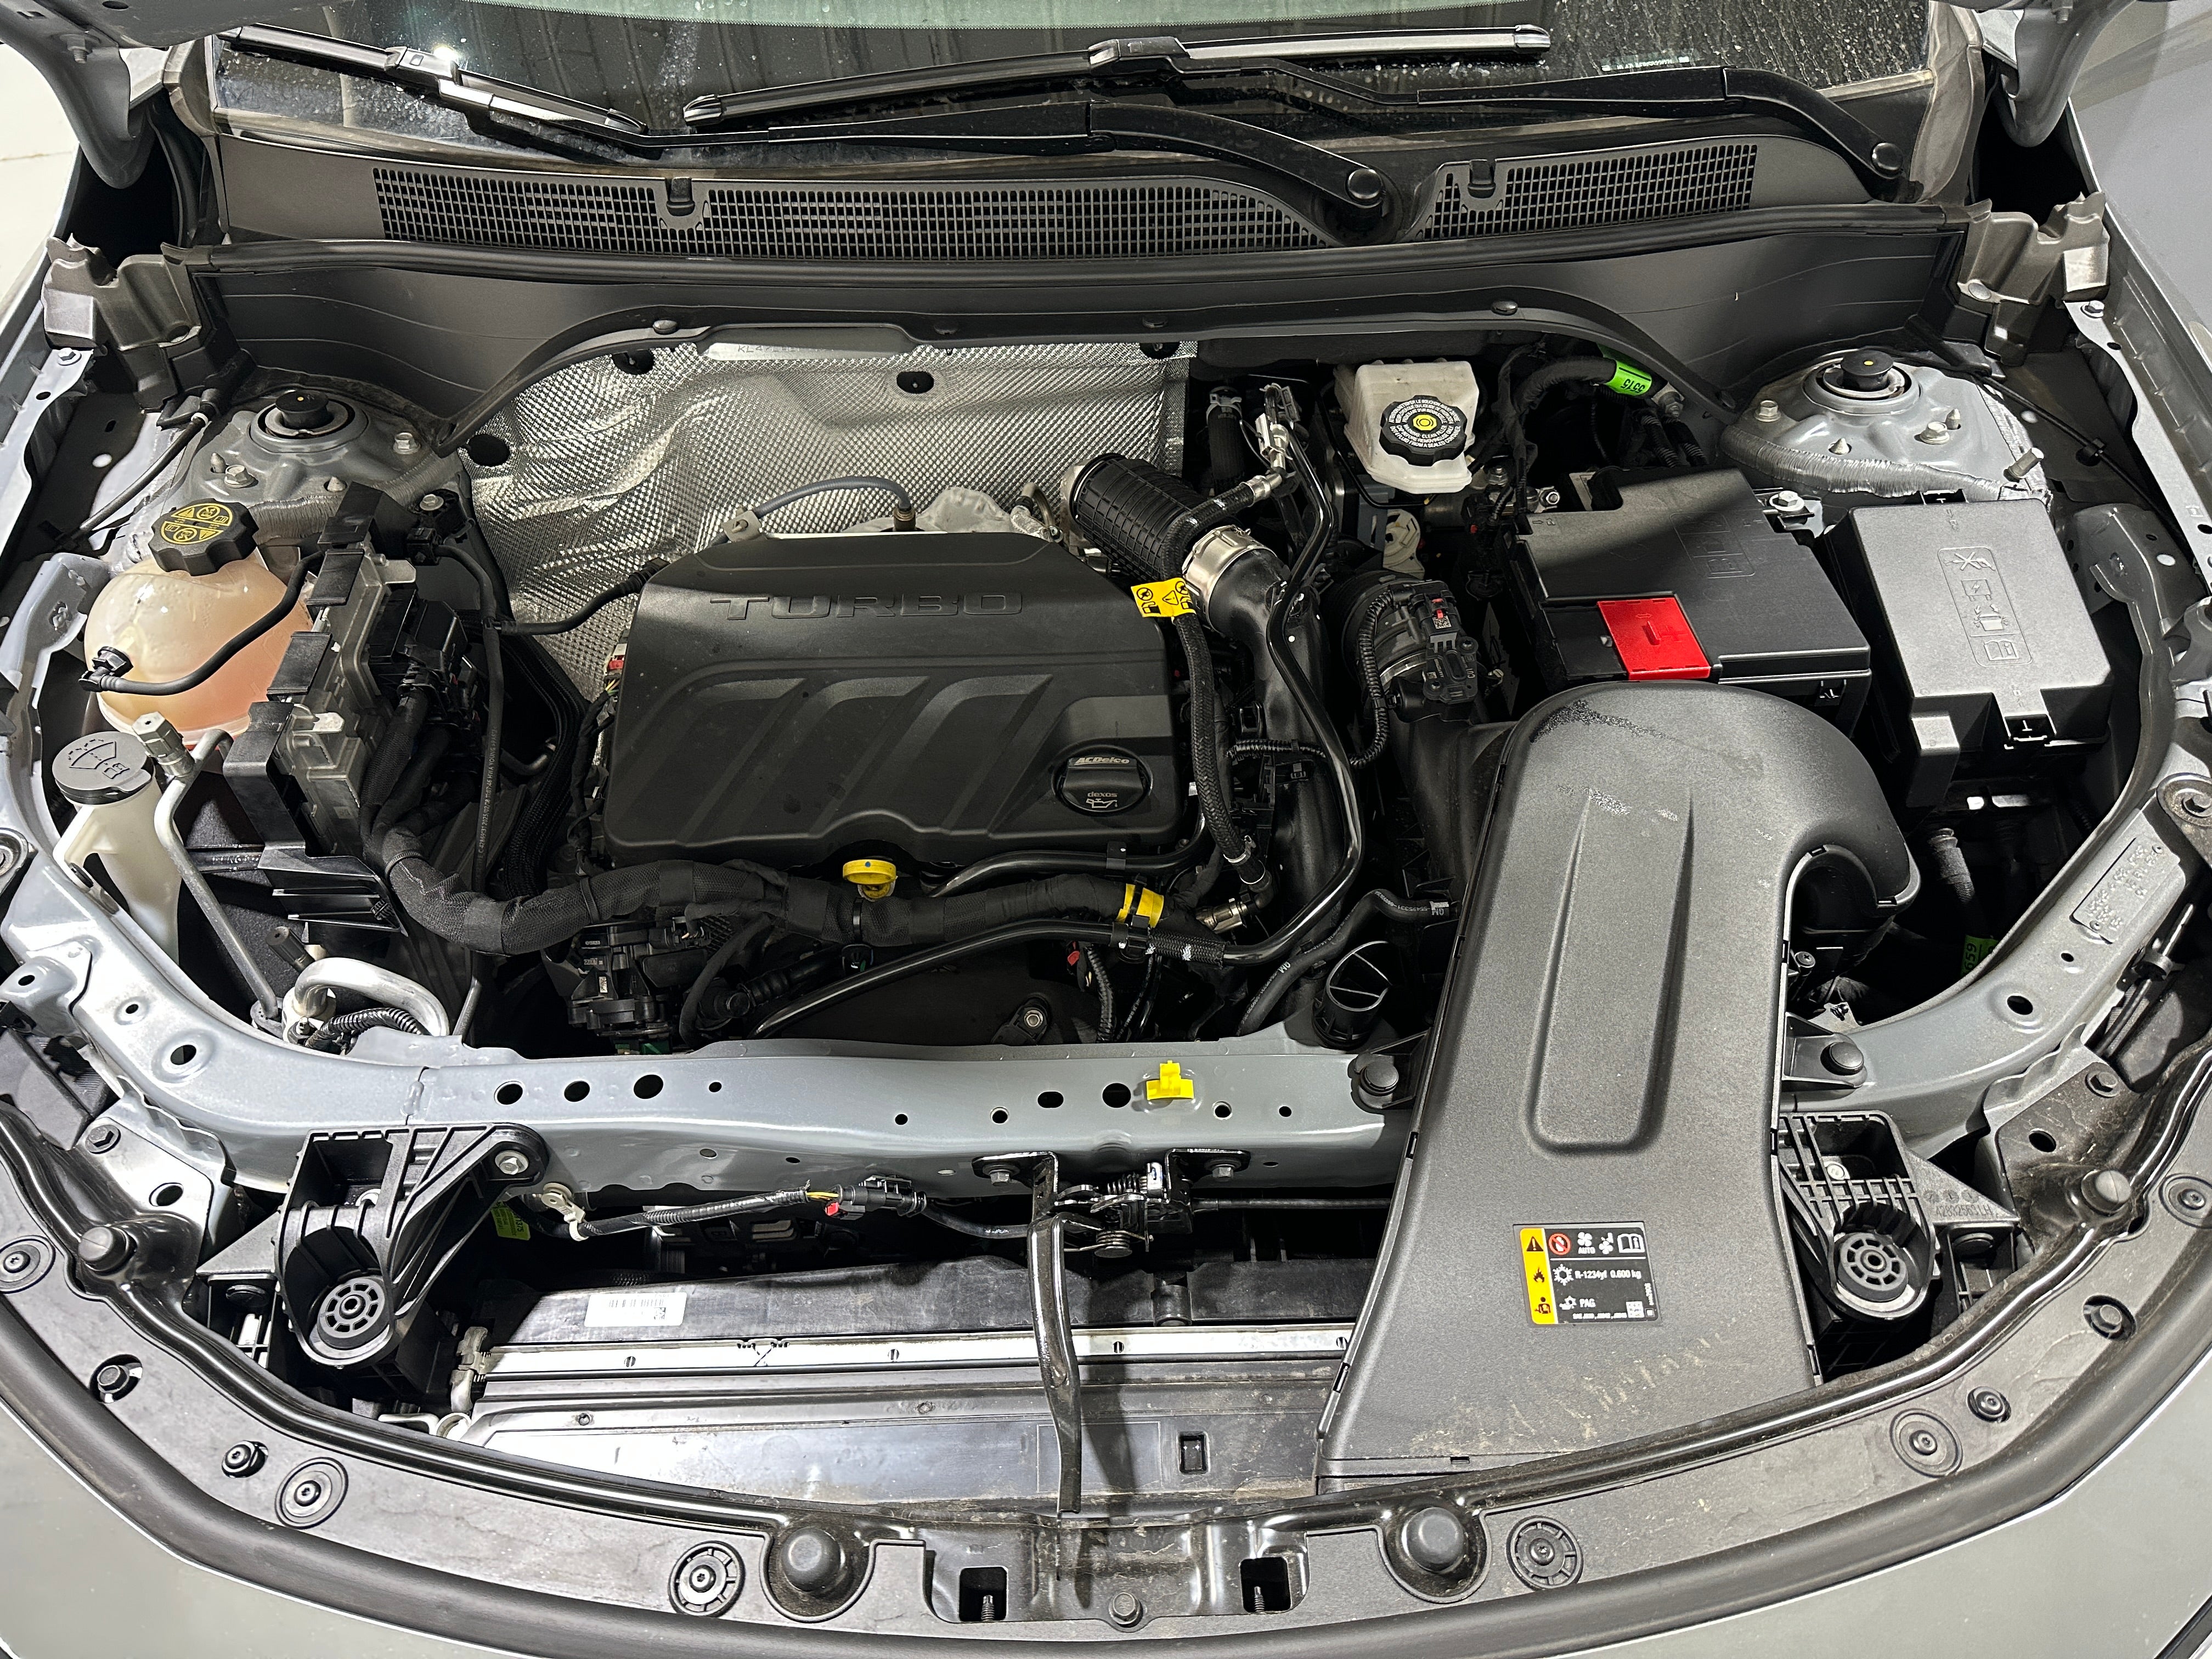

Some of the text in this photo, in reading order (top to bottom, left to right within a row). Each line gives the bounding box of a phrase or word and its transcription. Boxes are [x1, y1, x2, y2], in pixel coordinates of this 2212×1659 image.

[1621, 379, 1645, 393] 5515
[709, 594, 1023, 620] TURBO
[1075, 757, 1130, 765] ACDelco
[1278, 961, 1291, 974] GM
[1578, 1246, 1595, 1255] AUTO
[1575, 1269, 1607, 1280] R-1234yf
[1632, 1269, 1641, 1280] kg
[1579, 1298, 1596, 1308] PAG
